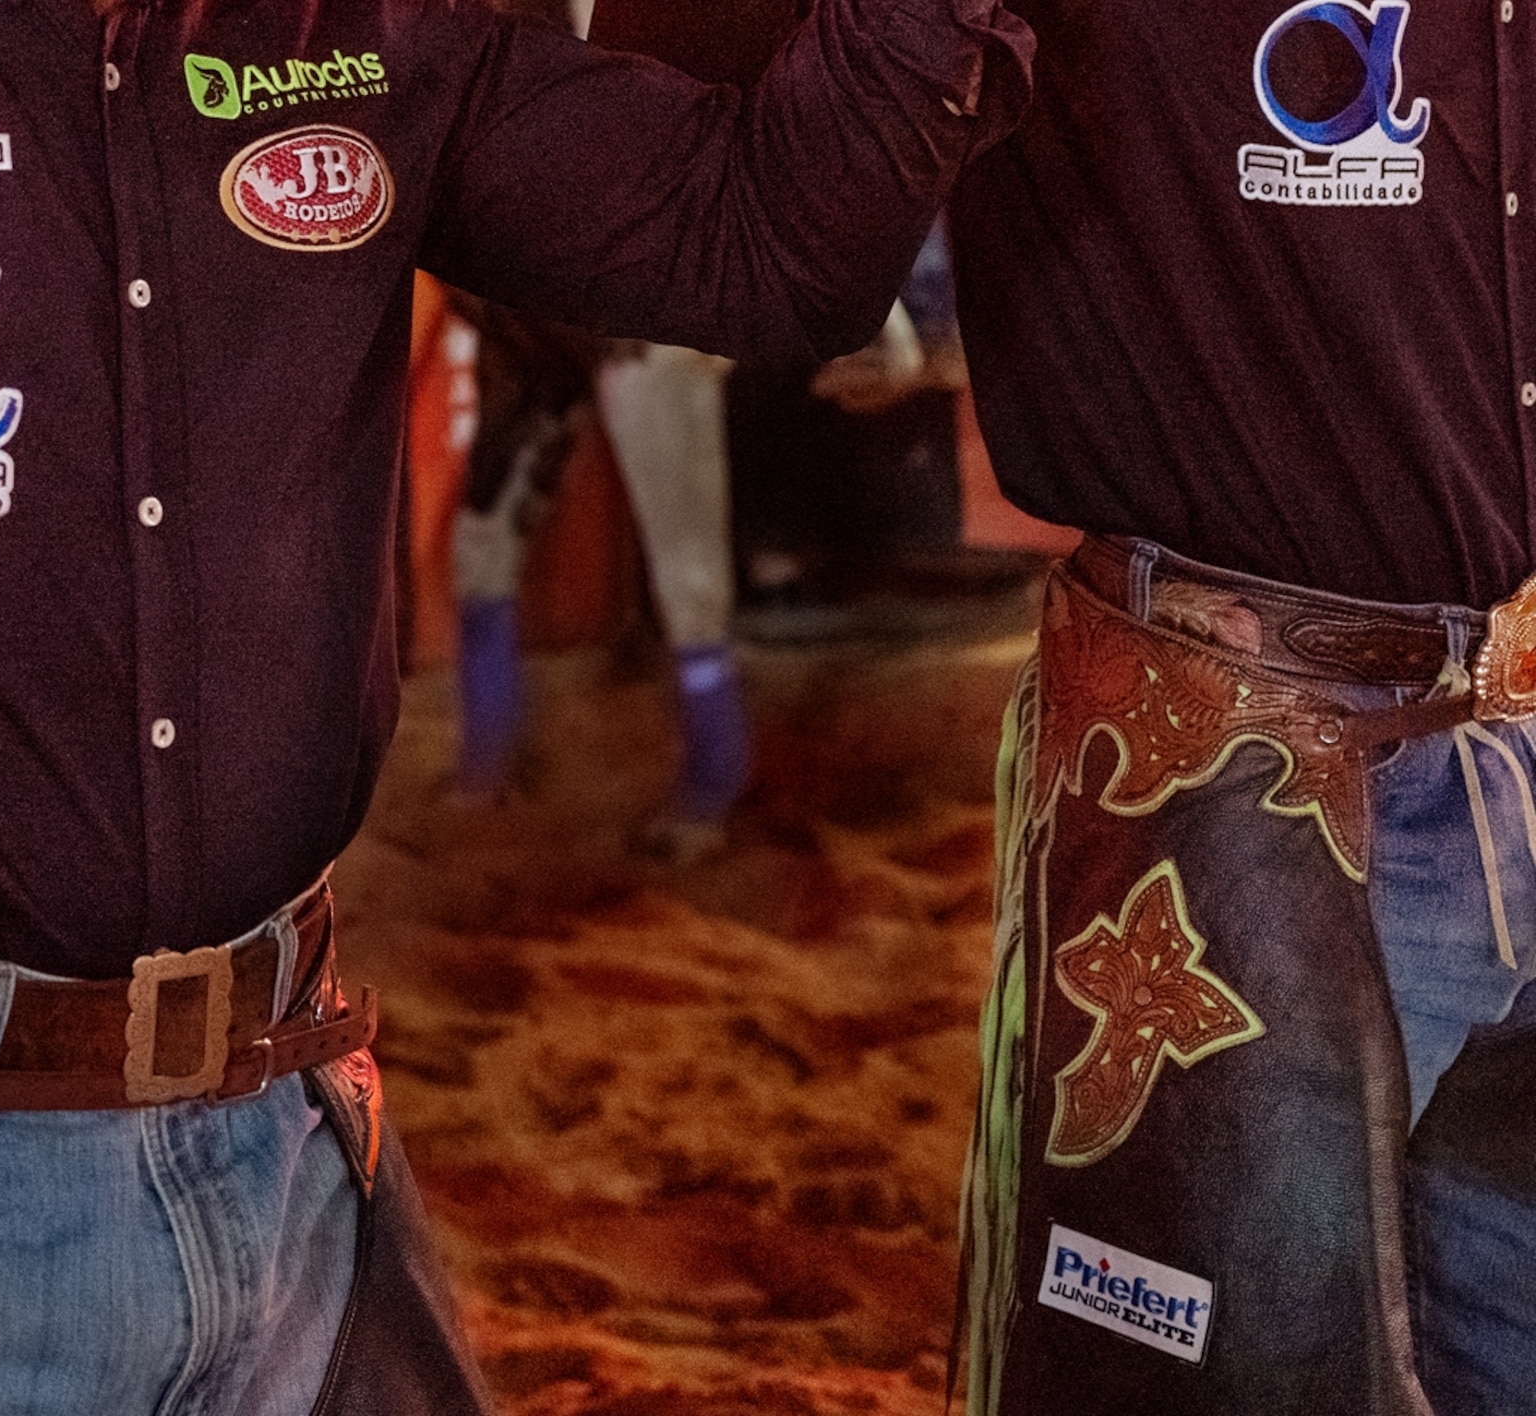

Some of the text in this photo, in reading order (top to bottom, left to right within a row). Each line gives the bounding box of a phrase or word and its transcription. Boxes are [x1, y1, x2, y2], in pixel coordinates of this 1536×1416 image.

[242, 49, 386, 102] Aurochs
[243, 90, 328, 114] COUNTRY
[283, 145, 355, 199] JB
[1243, 151, 1420, 179] ALFA
[1244, 179, 1418, 201] contabilidade
[283, 193, 362, 222] RODEIOS
